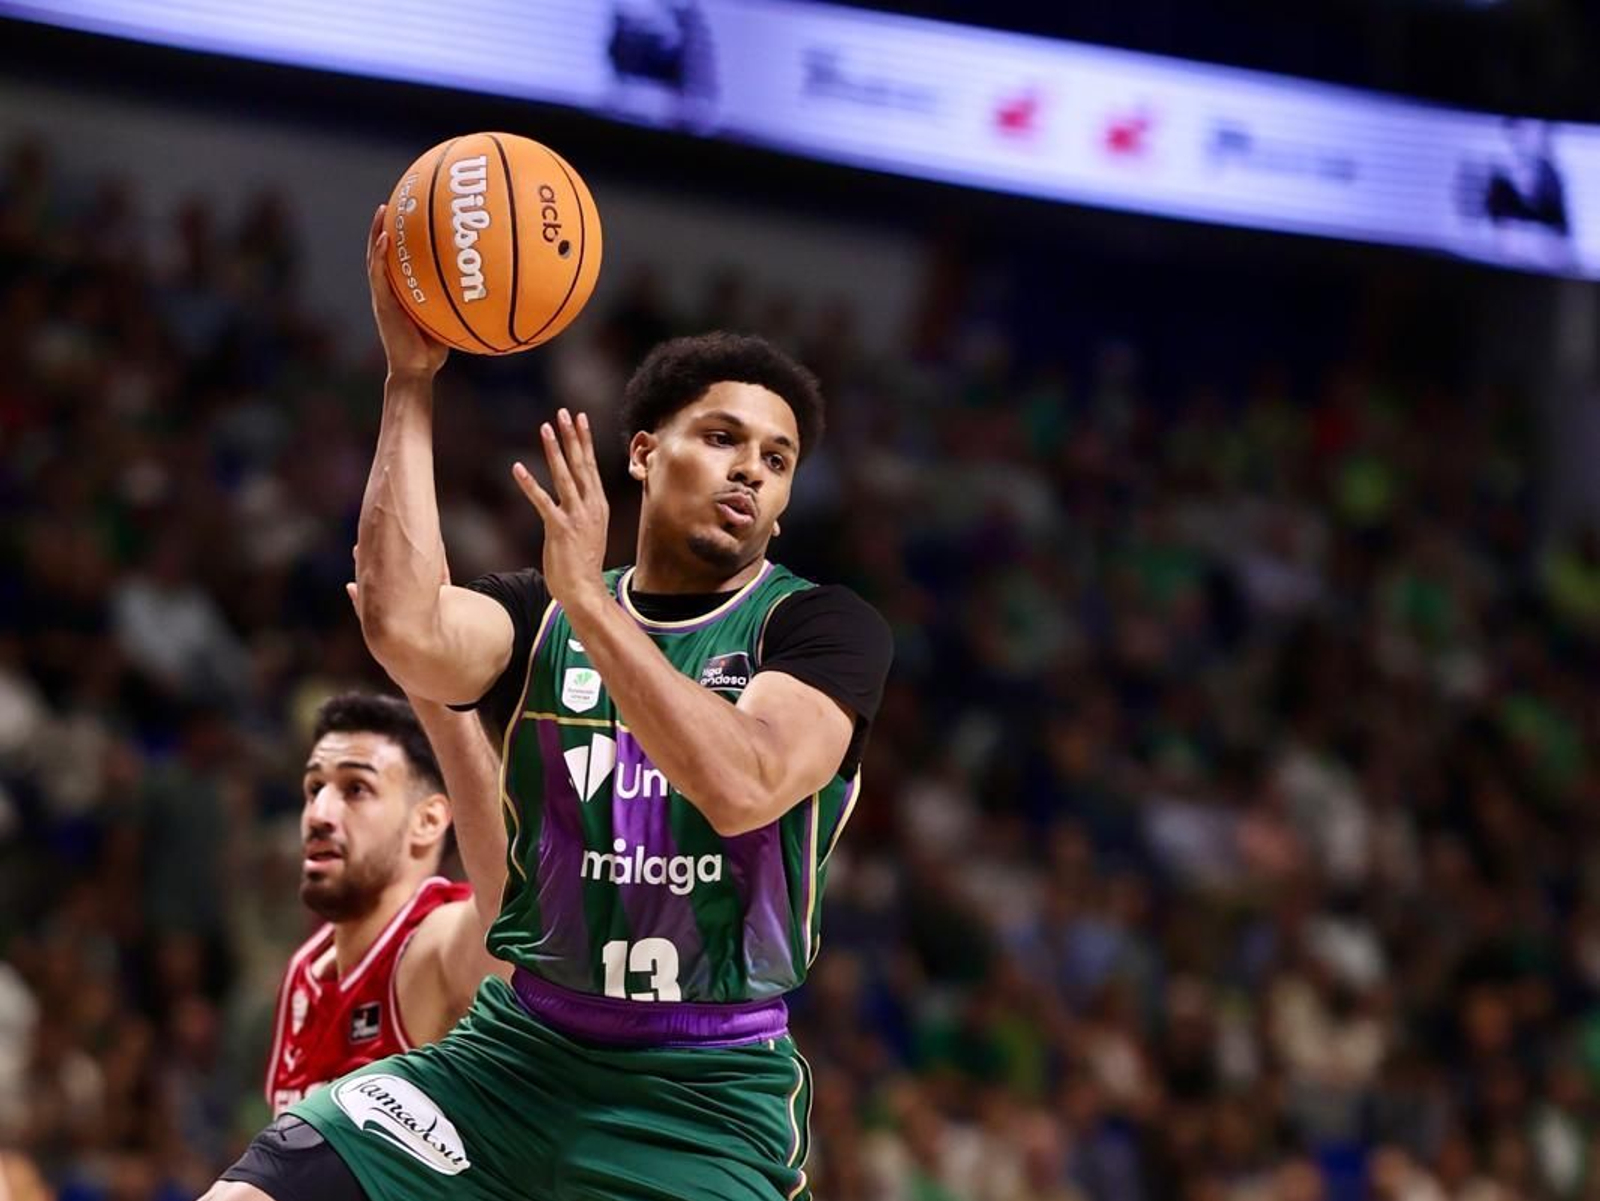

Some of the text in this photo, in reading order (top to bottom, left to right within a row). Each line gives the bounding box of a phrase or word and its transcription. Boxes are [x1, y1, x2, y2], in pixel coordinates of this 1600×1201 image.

[450, 155, 490, 303] Wilson
[539, 184, 562, 243] acb
[395, 215, 427, 304] endesa
[602, 937, 682, 1003] 13
